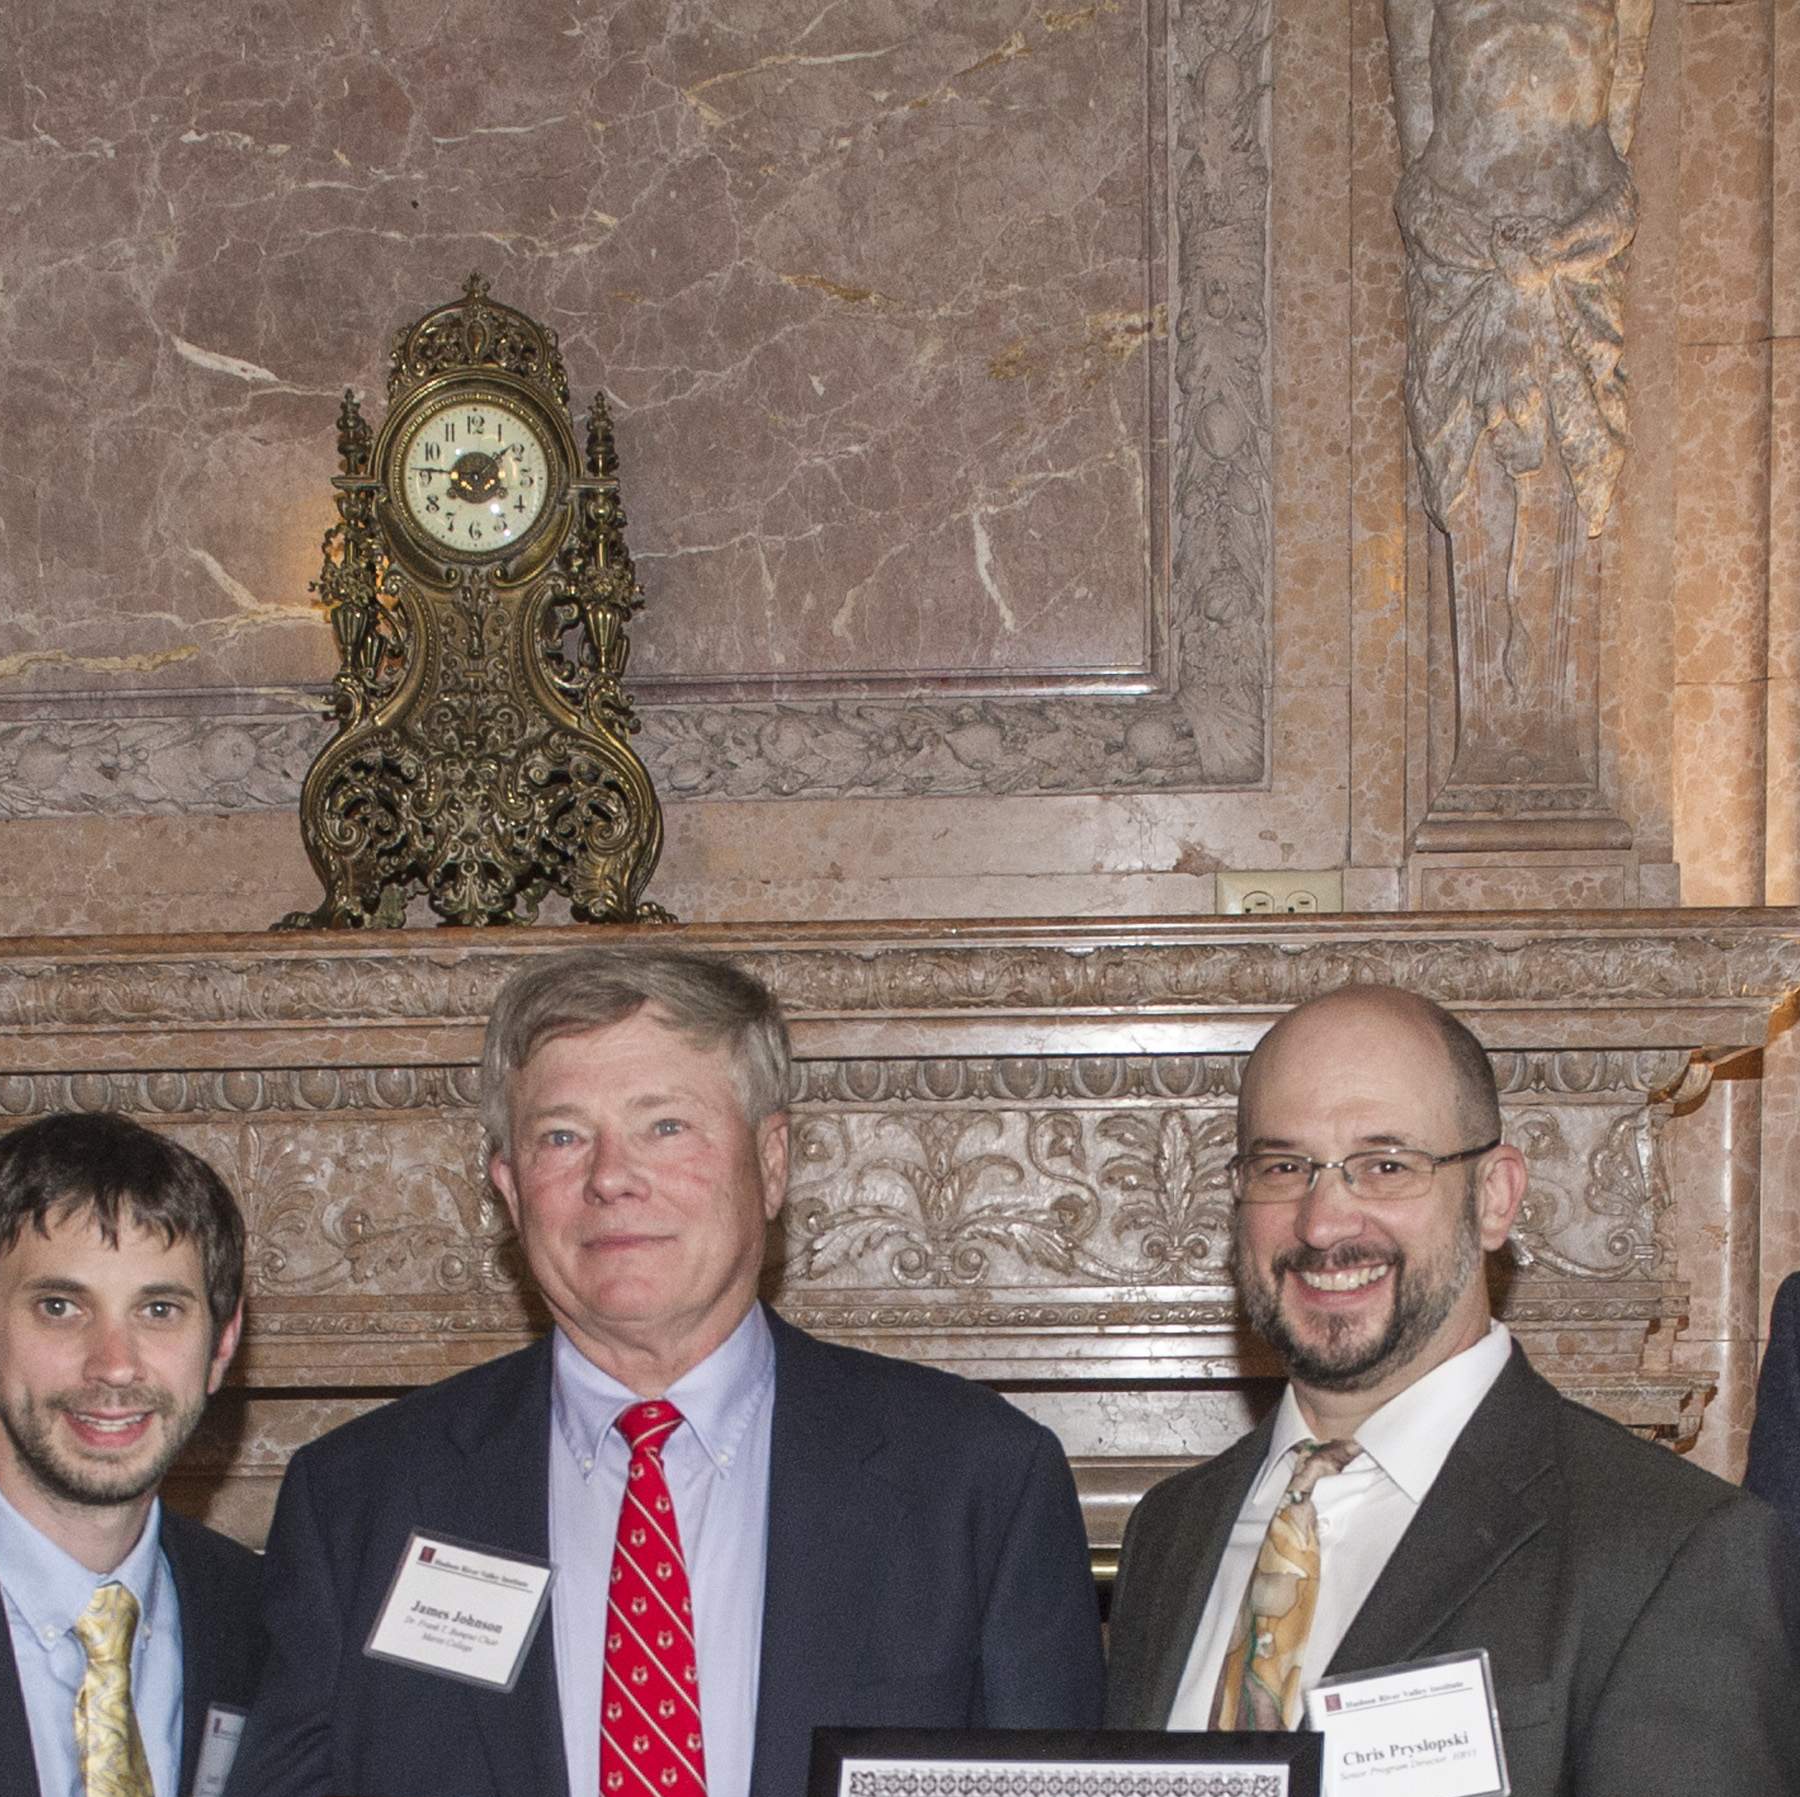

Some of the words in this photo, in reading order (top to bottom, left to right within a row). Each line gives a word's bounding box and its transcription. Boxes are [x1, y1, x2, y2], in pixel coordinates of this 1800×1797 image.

[445, 423, 455, 442] 11
[467, 415, 485, 434] 12
[425, 442, 440, 461] 10
[511, 443, 525, 462] 2
[419, 470, 432, 486] 9
[520, 468, 534, 487] 3
[426, 495, 439, 513] 8
[514, 495, 526, 513] 4
[446, 512, 455, 532] 7
[469, 520, 482, 540] 6
[493, 514, 507, 532] 5
[410, 1600, 449, 1620] James
[451, 1611, 503, 1634] Johnson
[1343, 1747, 1385, 1766] Chris
[1389, 1731, 1469, 1759] Pryslopski
